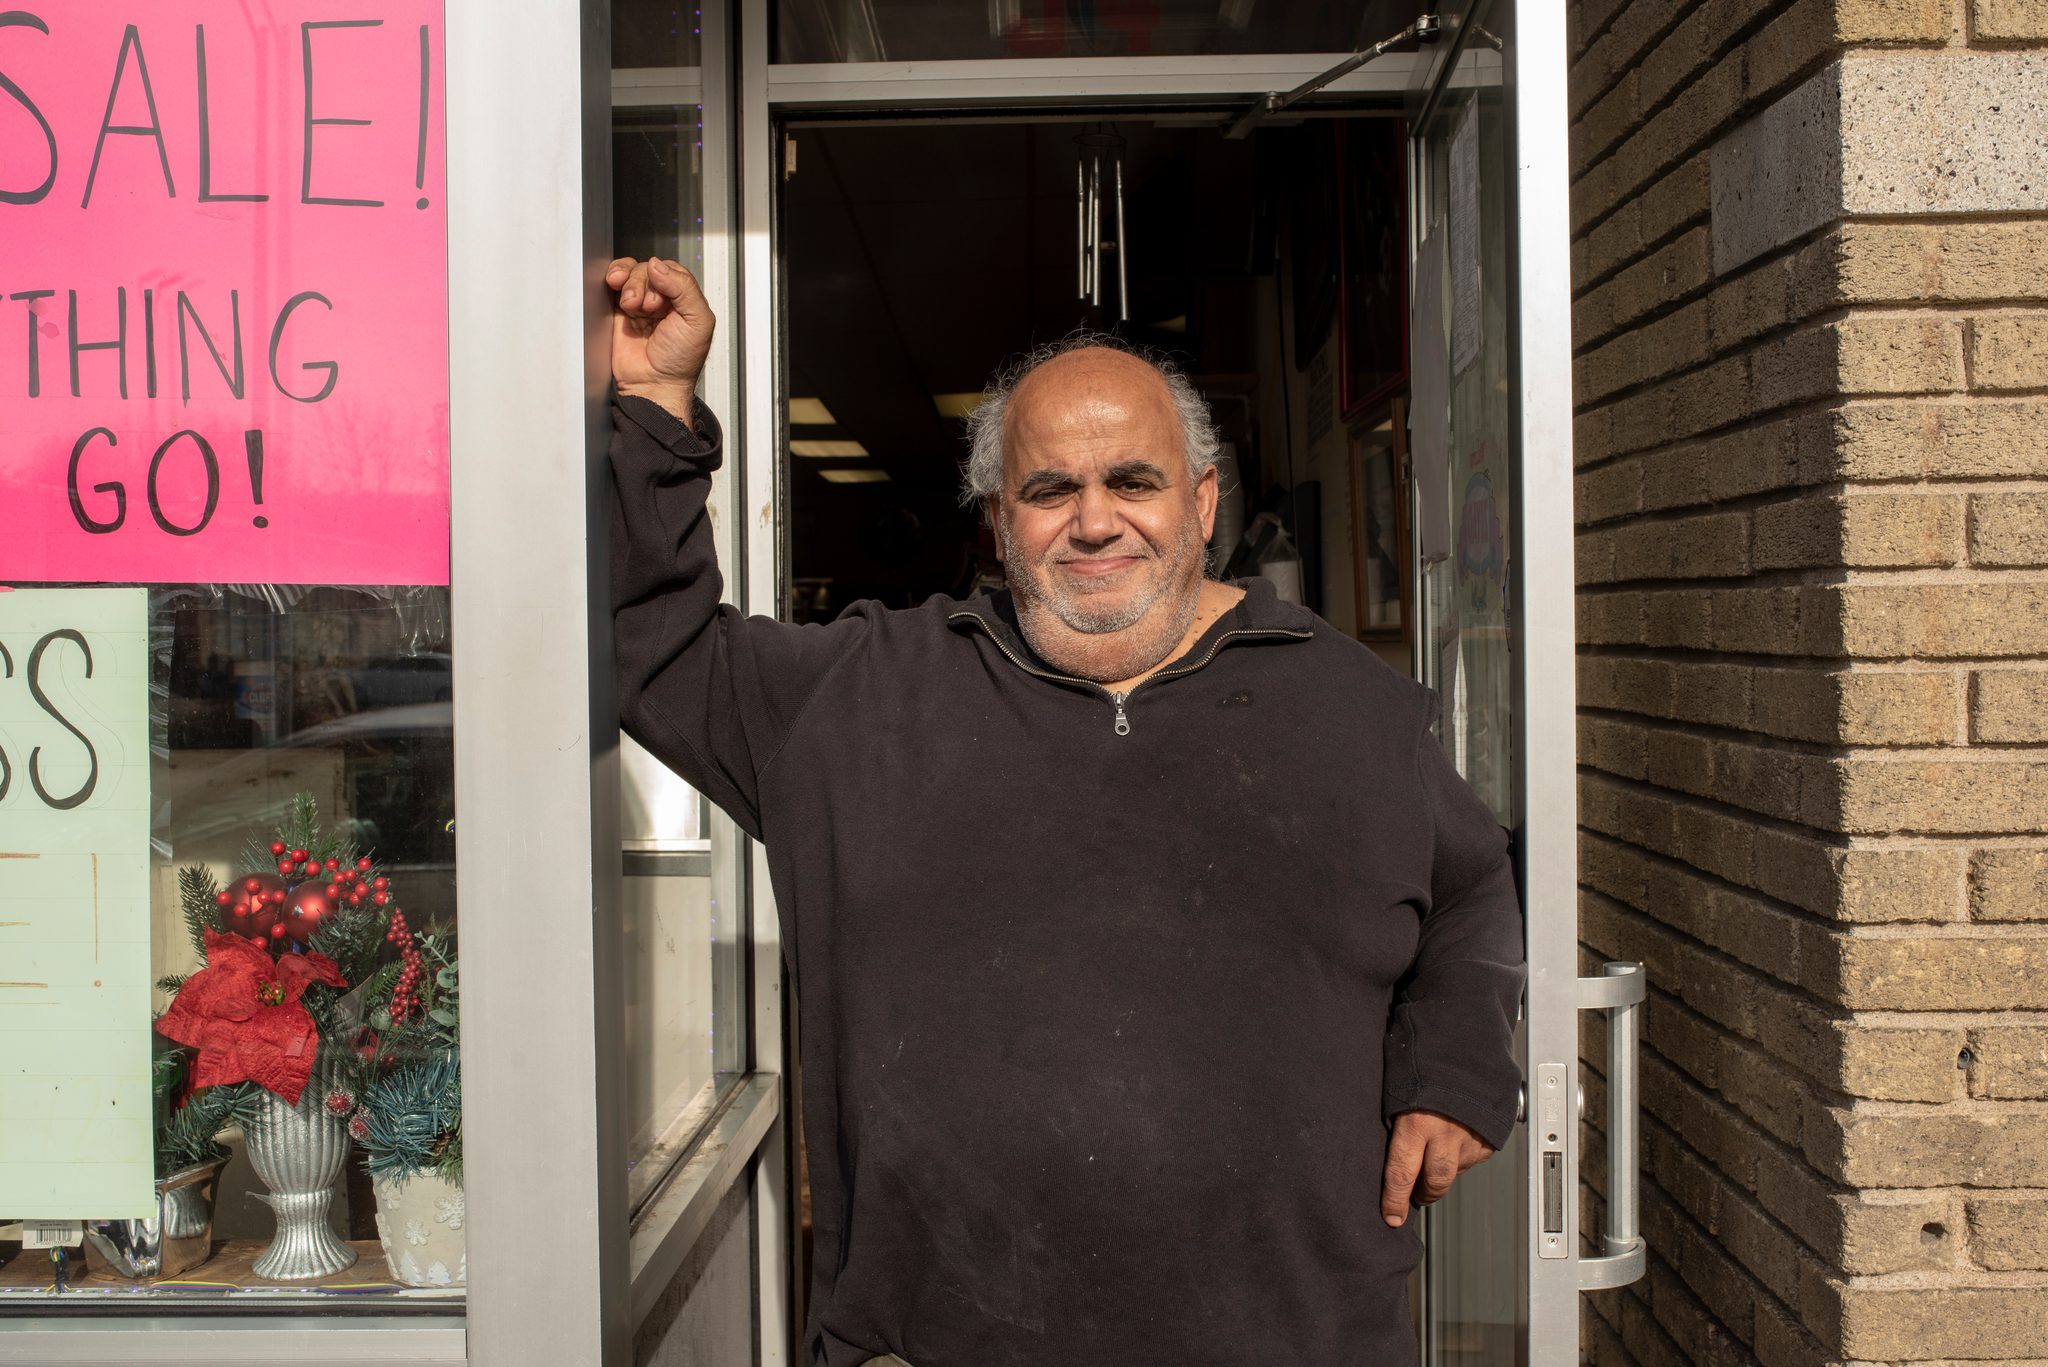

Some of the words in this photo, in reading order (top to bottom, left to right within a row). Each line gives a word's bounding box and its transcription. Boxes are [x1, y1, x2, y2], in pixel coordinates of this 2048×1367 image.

[0, 10, 430, 210] SALE!
[0, 286, 339, 408] THING
[67, 427, 268, 536] GO!
[0, 629, 98, 810] S
